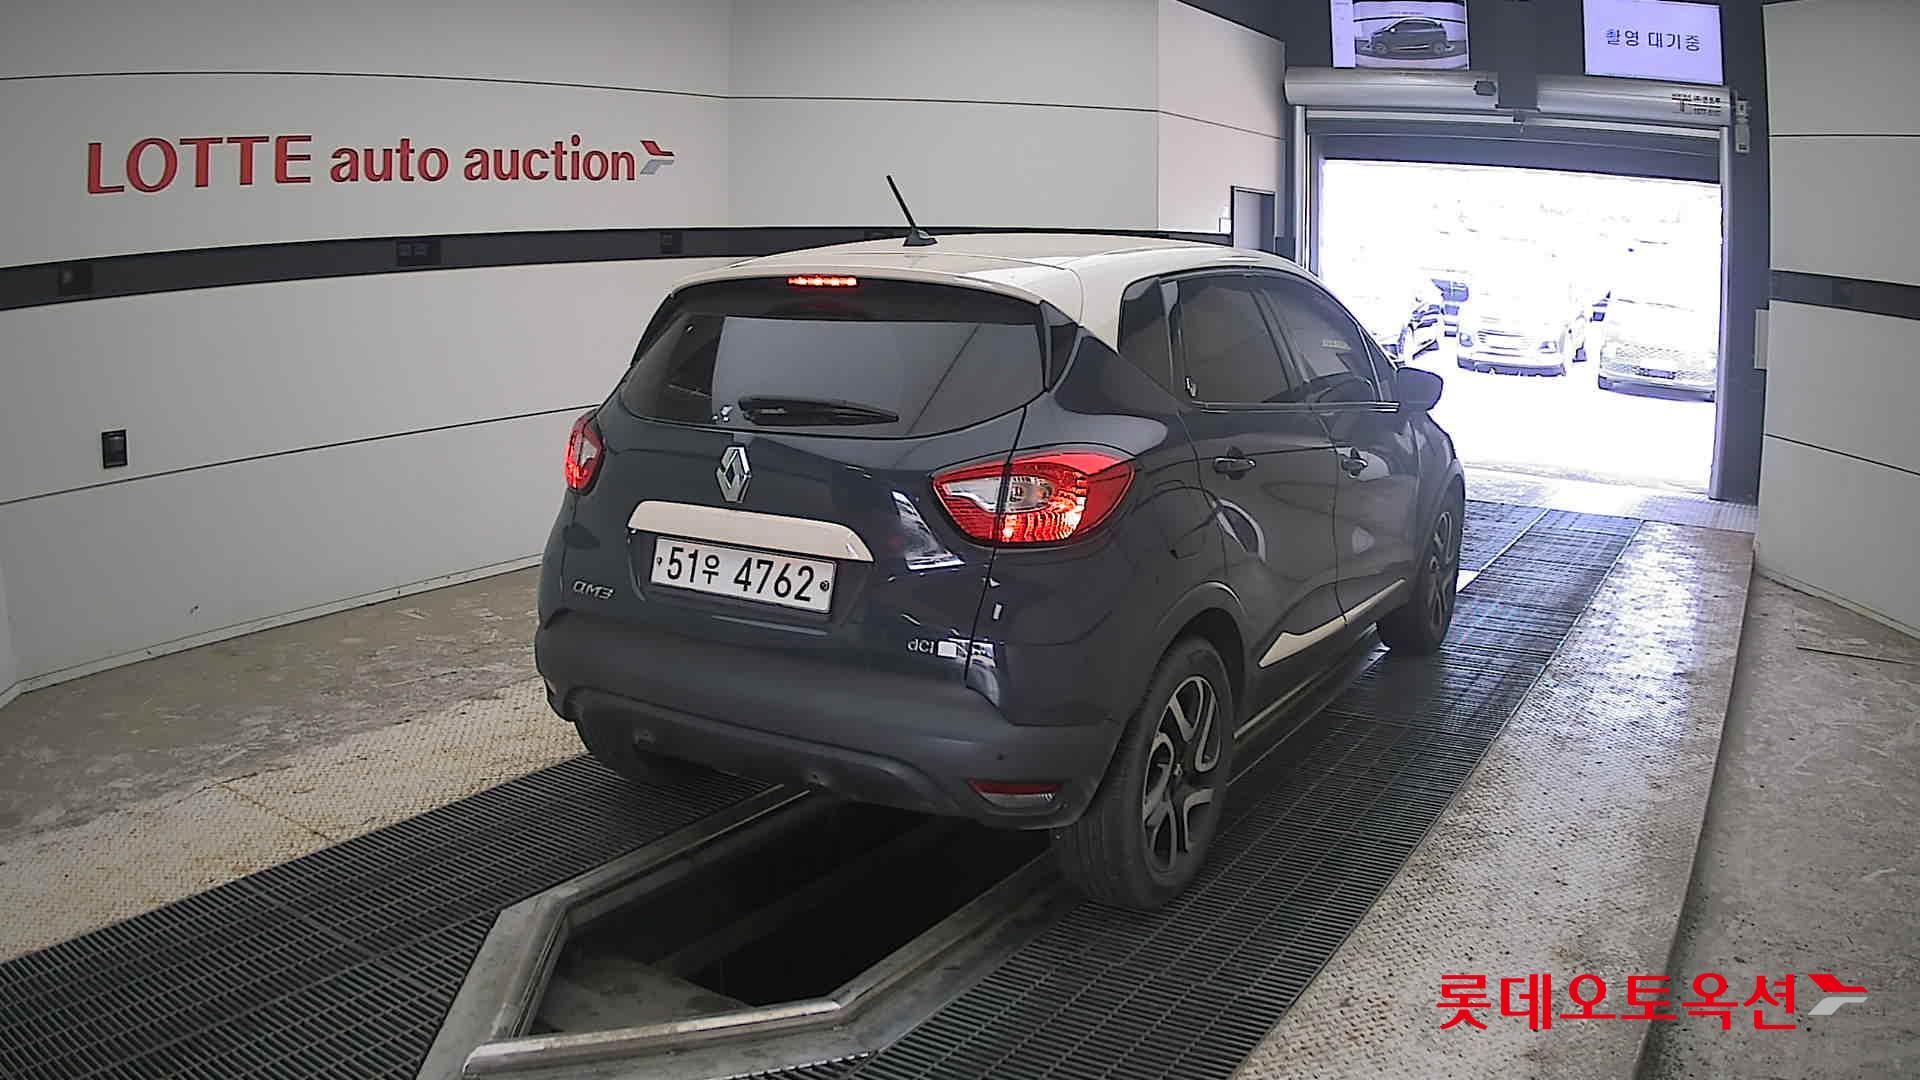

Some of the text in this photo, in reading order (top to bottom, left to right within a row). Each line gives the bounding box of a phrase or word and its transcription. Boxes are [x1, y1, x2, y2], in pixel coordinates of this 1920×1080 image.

[87, 133, 636, 195] LOTTE auto auction
[666, 545, 815, 603] 51우 4762
